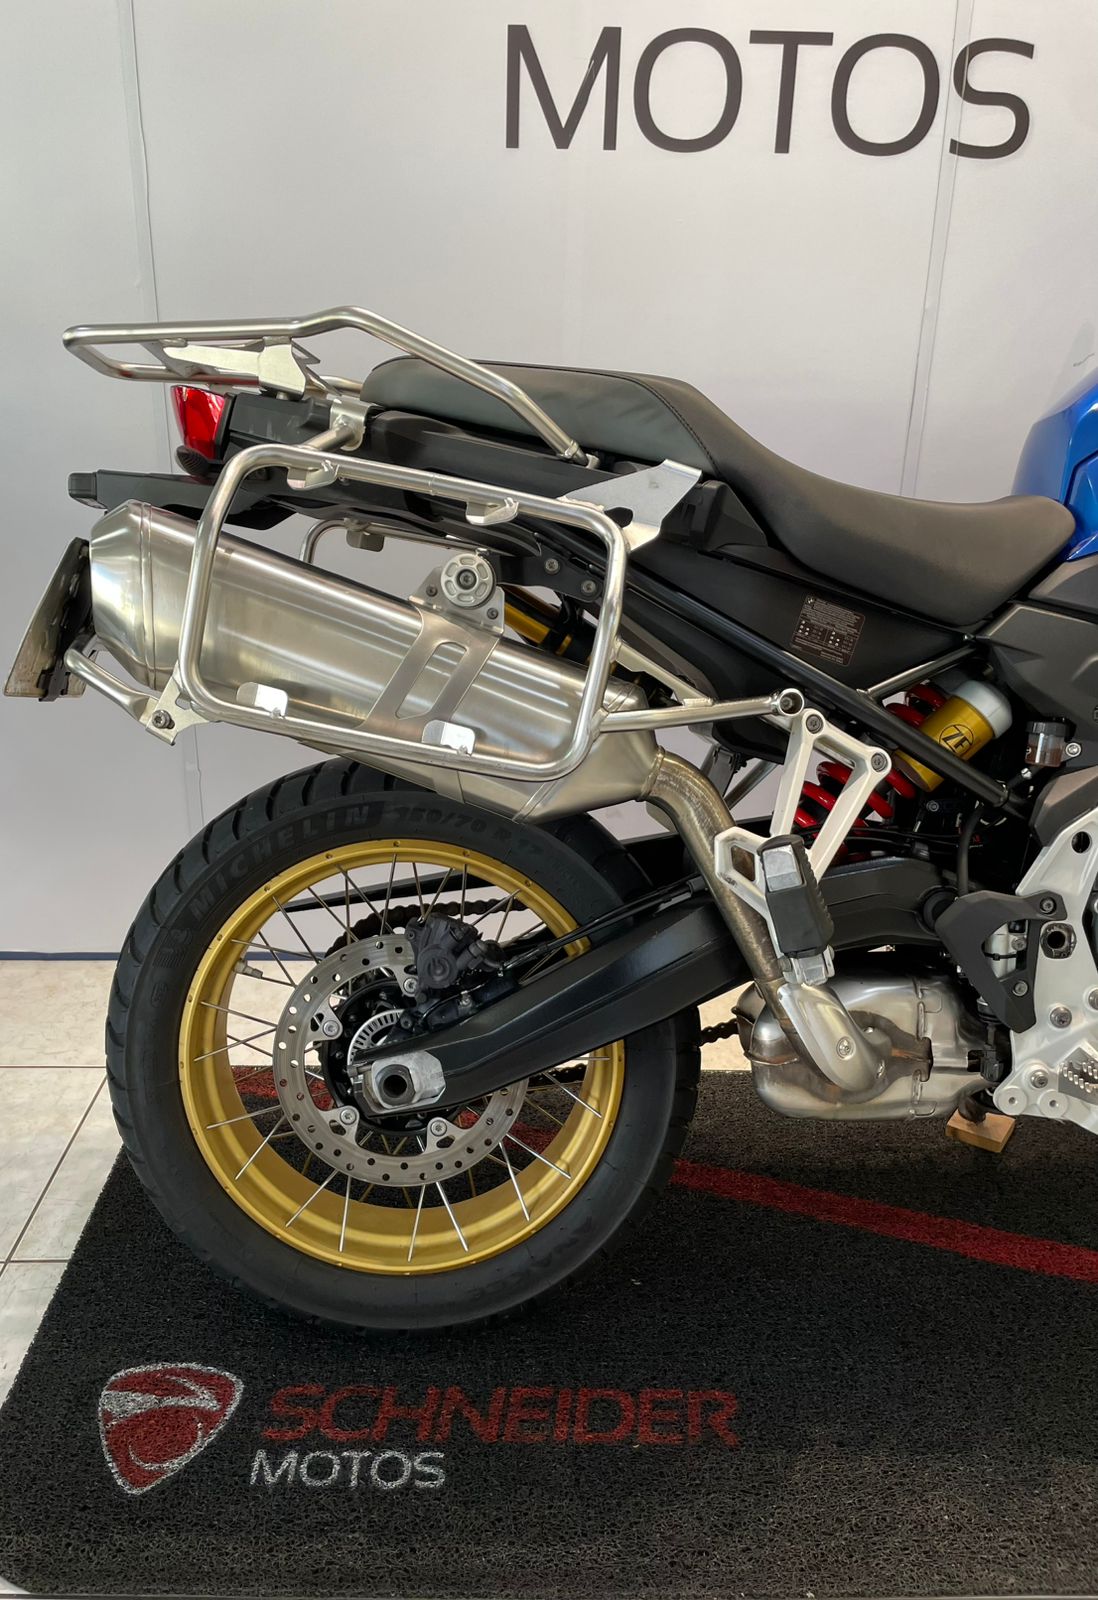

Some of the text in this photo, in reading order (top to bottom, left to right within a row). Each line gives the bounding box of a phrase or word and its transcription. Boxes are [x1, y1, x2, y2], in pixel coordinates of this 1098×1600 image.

[505, 24, 1035, 159] MOTOS
[939, 725, 973, 755] ZF
[188, 804, 371, 921] MICHELIN
[262, 1384, 741, 1448] SCHNEIDER
[249, 1448, 447, 1490] MOTOS
